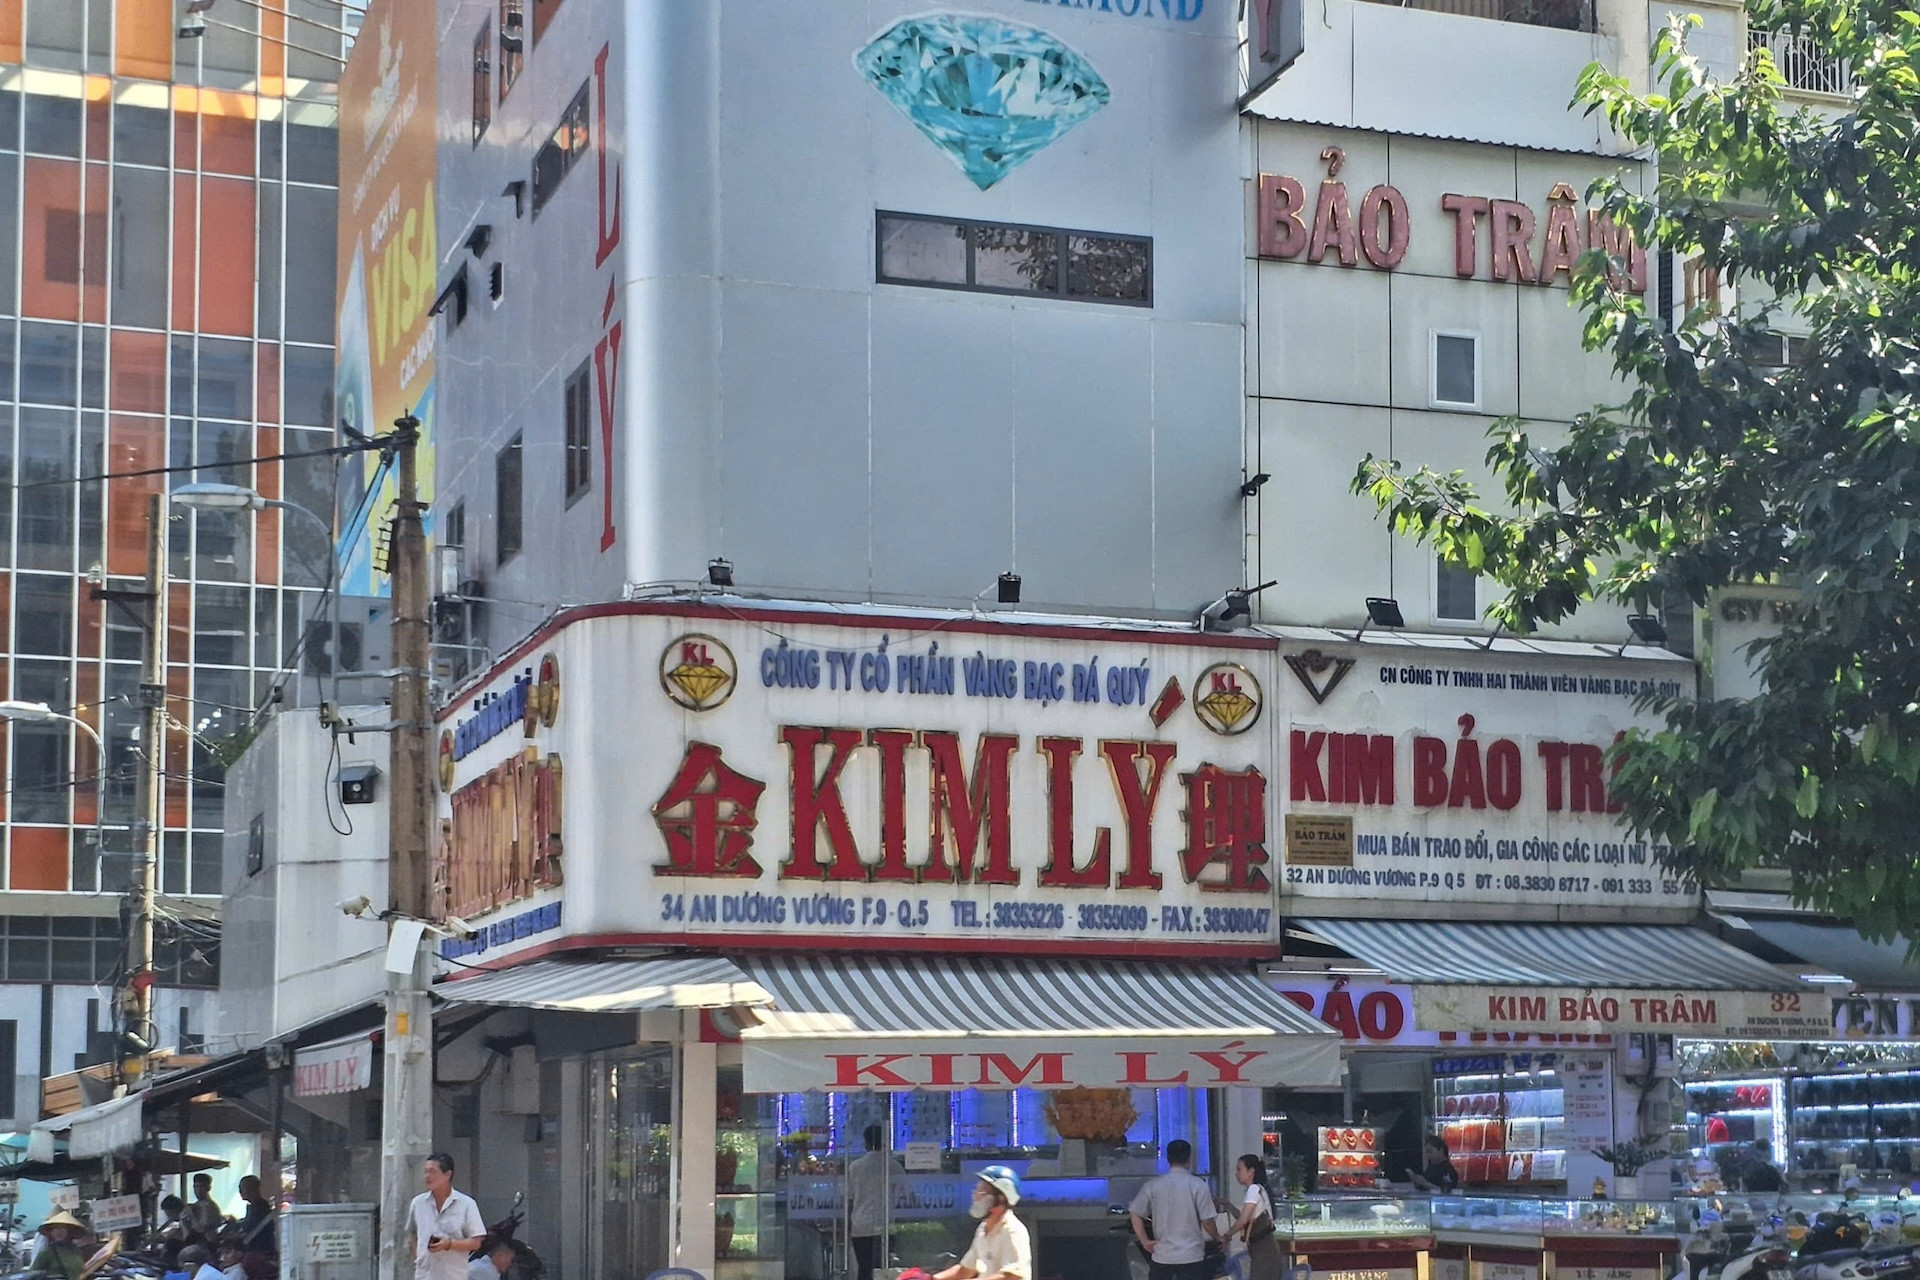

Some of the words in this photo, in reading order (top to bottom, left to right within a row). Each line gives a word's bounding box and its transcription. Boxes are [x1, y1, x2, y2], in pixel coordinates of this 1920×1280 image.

[1258, 146, 1411, 271] BẢO
[1441, 182, 1648, 295] TRÂM
[371, 181, 437, 367] VISA
[682, 642, 715, 665] KL
[761, 637, 820, 689] CÔNG
[827, 651, 856, 691] TY
[860, 633, 890, 692] CỔ
[897, 641, 955, 695] PHẦN
[963, 650, 1017, 698] VÀNG
[1024, 660, 1065, 707] BẠC
[1072, 655, 1100, 703] ĐÁ
[1106, 657, 1150, 706] QUÝ
[1210, 672, 1242, 692] KL
[1400, 666, 1433, 687] CÔNG
[1436, 668, 1450, 686] TY
[1453, 670, 1485, 689] TNHH
[1486, 671, 1507, 690] HAI
[1551, 672, 1577, 694] VIÊN
[1581, 673, 1611, 695] VÀNG
[1613, 678, 1637, 699] BẠC
[1290, 730, 1394, 805] KIM
[1413, 713, 1521, 811] BẢO
[1538, 730, 1631, 813] TR
[779, 725, 1020, 886] KIM
[1036, 675, 1186, 891] LÝ
[651, 740, 766, 880] 金
[1357, 834, 1387, 856] MUA
[1391, 832, 1420, 857] BÁN
[1425, 837, 1461, 859] TRAO
[1496, 839, 1518, 861] GIA
[1522, 836, 1559, 862] CÔNG
[1563, 838, 1590, 863] CÁC
[1594, 842, 1625, 868] LOẠI
[1286, 868, 1303, 883] 32
[1306, 868, 1324, 884] AN
[1328, 868, 1371, 886] DƯƠNG
[1375, 869, 1416, 887] VƯƠNG
[1419, 872, 1439, 888] P.9
[1504, 874, 1555, 891] 08.3830
[1601, 878, 1624, 893] 091
[1629, 879, 1652, 894] 333
[661, 893, 684, 921] 34
[689, 894, 717, 923] AN
[722, 891, 786, 924] DƯƠNG
[792, 892, 855, 926] VƯƠNG
[862, 898, 887, 926] F.9
[898, 900, 928, 927] Q.5
[993, 902, 1064, 930] 38353226
[1078, 904, 1148, 931] 38355099
[1488, 996, 1546, 1021] KIM
[1559, 988, 1619, 1022] BẢO
[1630, 993, 1717, 1024] TRÂM
[1771, 992, 1800, 1012] 32
[297, 1062, 329, 1092] KIM
[824, 1053, 1074, 1086] KIM
[1115, 1040, 1269, 1084] LÝ
